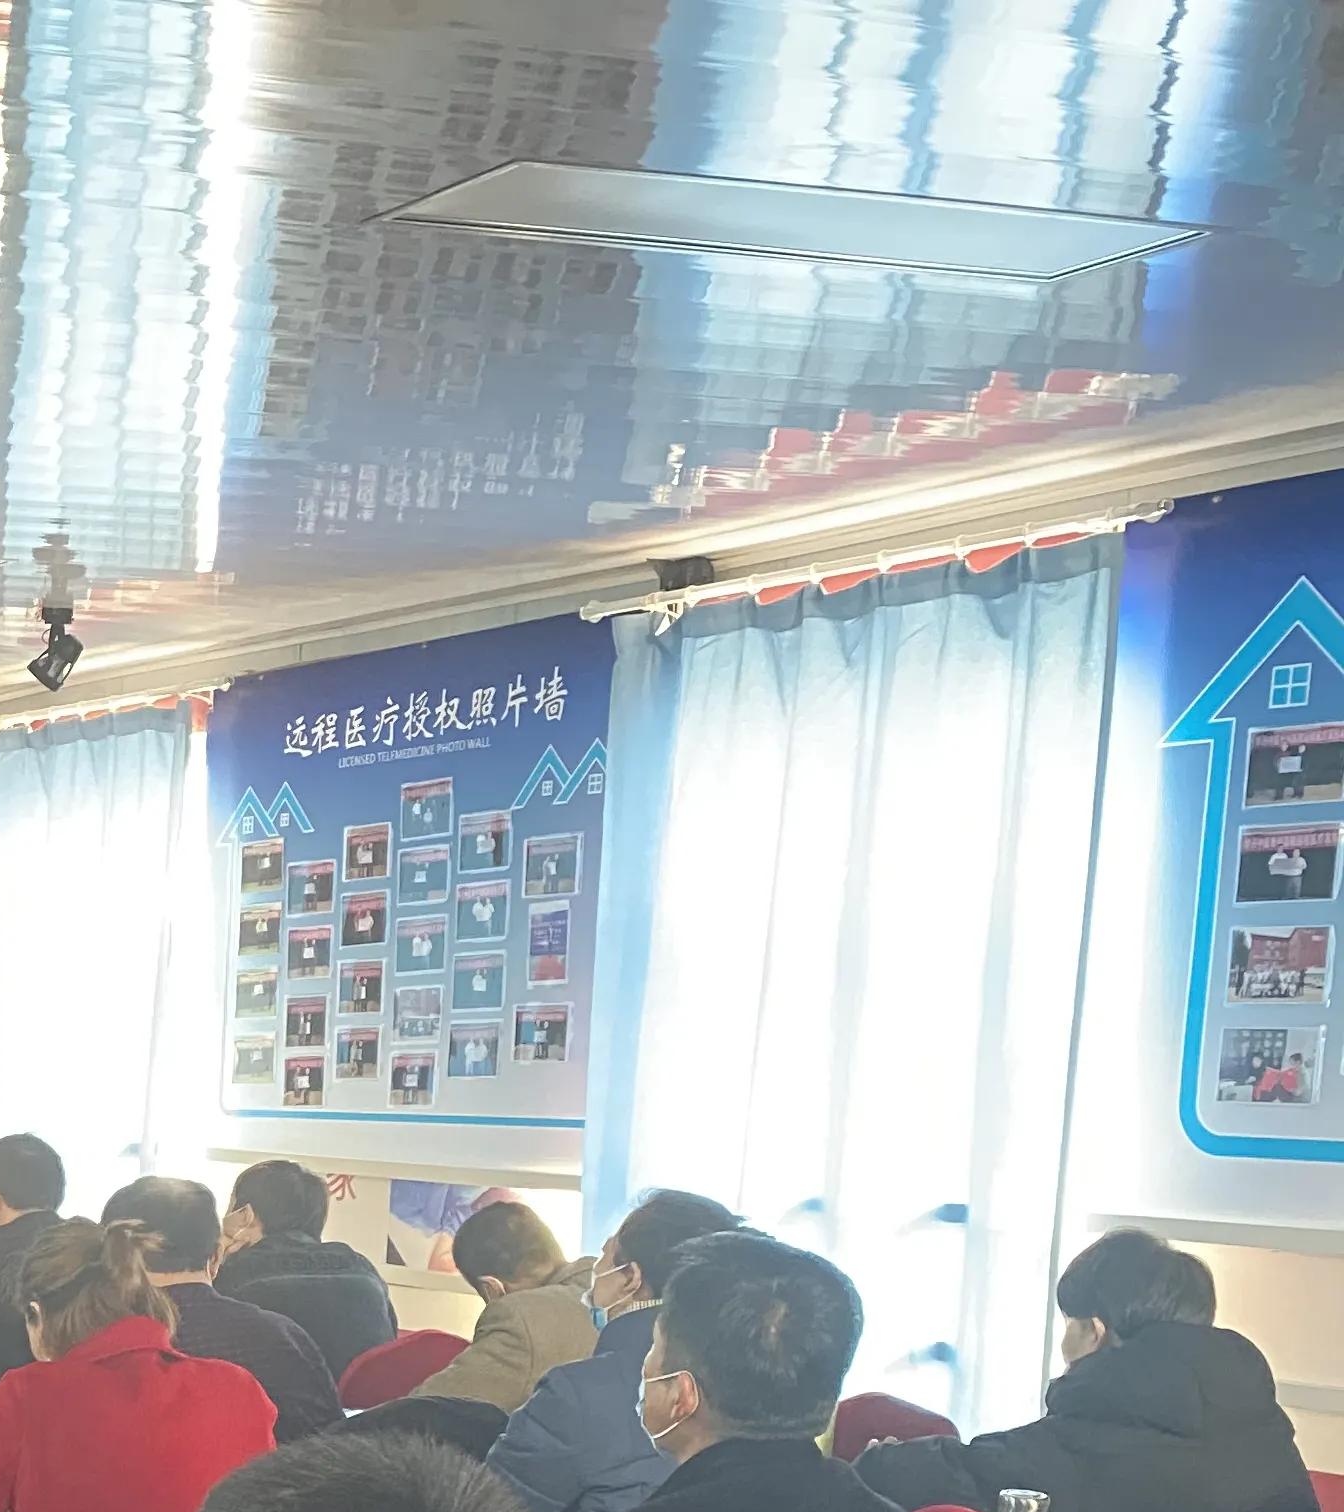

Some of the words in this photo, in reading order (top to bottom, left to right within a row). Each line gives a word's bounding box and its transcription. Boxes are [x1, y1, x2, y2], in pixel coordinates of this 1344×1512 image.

[283, 666, 569, 757] 远程医疗授权照片墙
[338, 753, 376, 769] LICENSED
[378, 745, 435, 763] TELEMEDICINE
[436, 740, 466, 754] PHOTO
[467, 736, 492, 750] WALL
